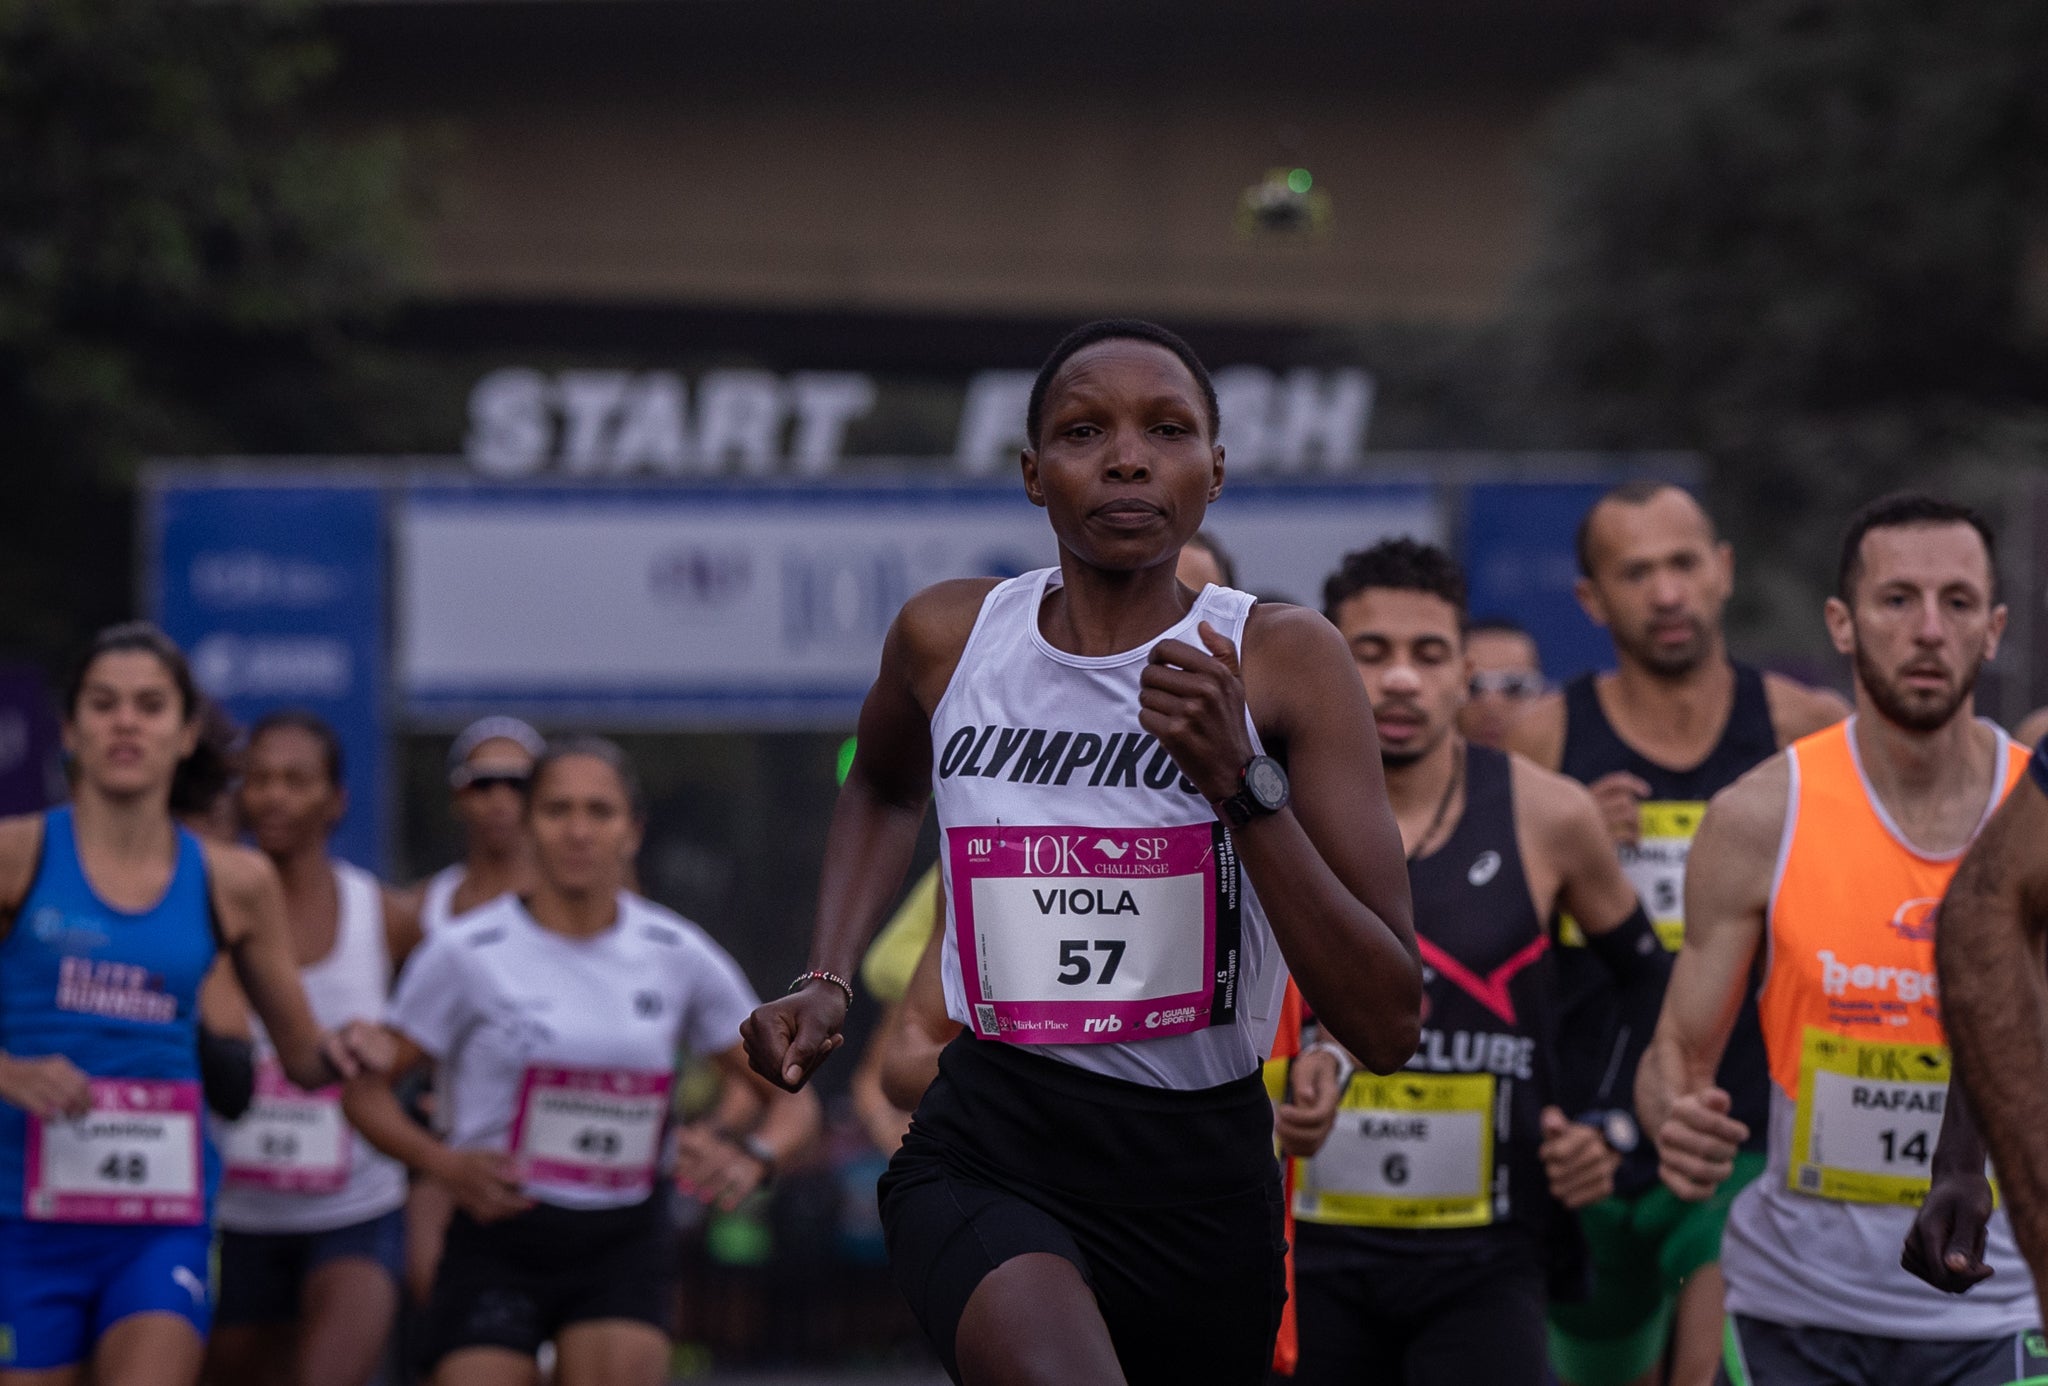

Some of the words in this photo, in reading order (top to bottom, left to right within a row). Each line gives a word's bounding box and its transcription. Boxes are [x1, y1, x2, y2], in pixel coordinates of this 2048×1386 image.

[468, 368, 874, 475] START
[1022, 835, 1090, 875] 10K
[1135, 837, 1168, 860] SP
[1094, 863, 1169, 875] CHALLENGE
[1032, 888, 1140, 915] VIOLA
[1057, 940, 1127, 985] 57
[1217, 970, 1227, 983] 57
[1013, 1019, 1041, 1030] Market
[1044, 1019, 1069, 1030] Place
[1083, 1014, 1122, 1032] rvb
[1161, 1013, 1196, 1026] SPORTS
[1162, 1006, 1196, 1018] IGUANA
[1853, 1086, 1944, 1114] RAFAE
[1879, 1129, 1929, 1164] 14
[1382, 1152, 1409, 1186] 6
